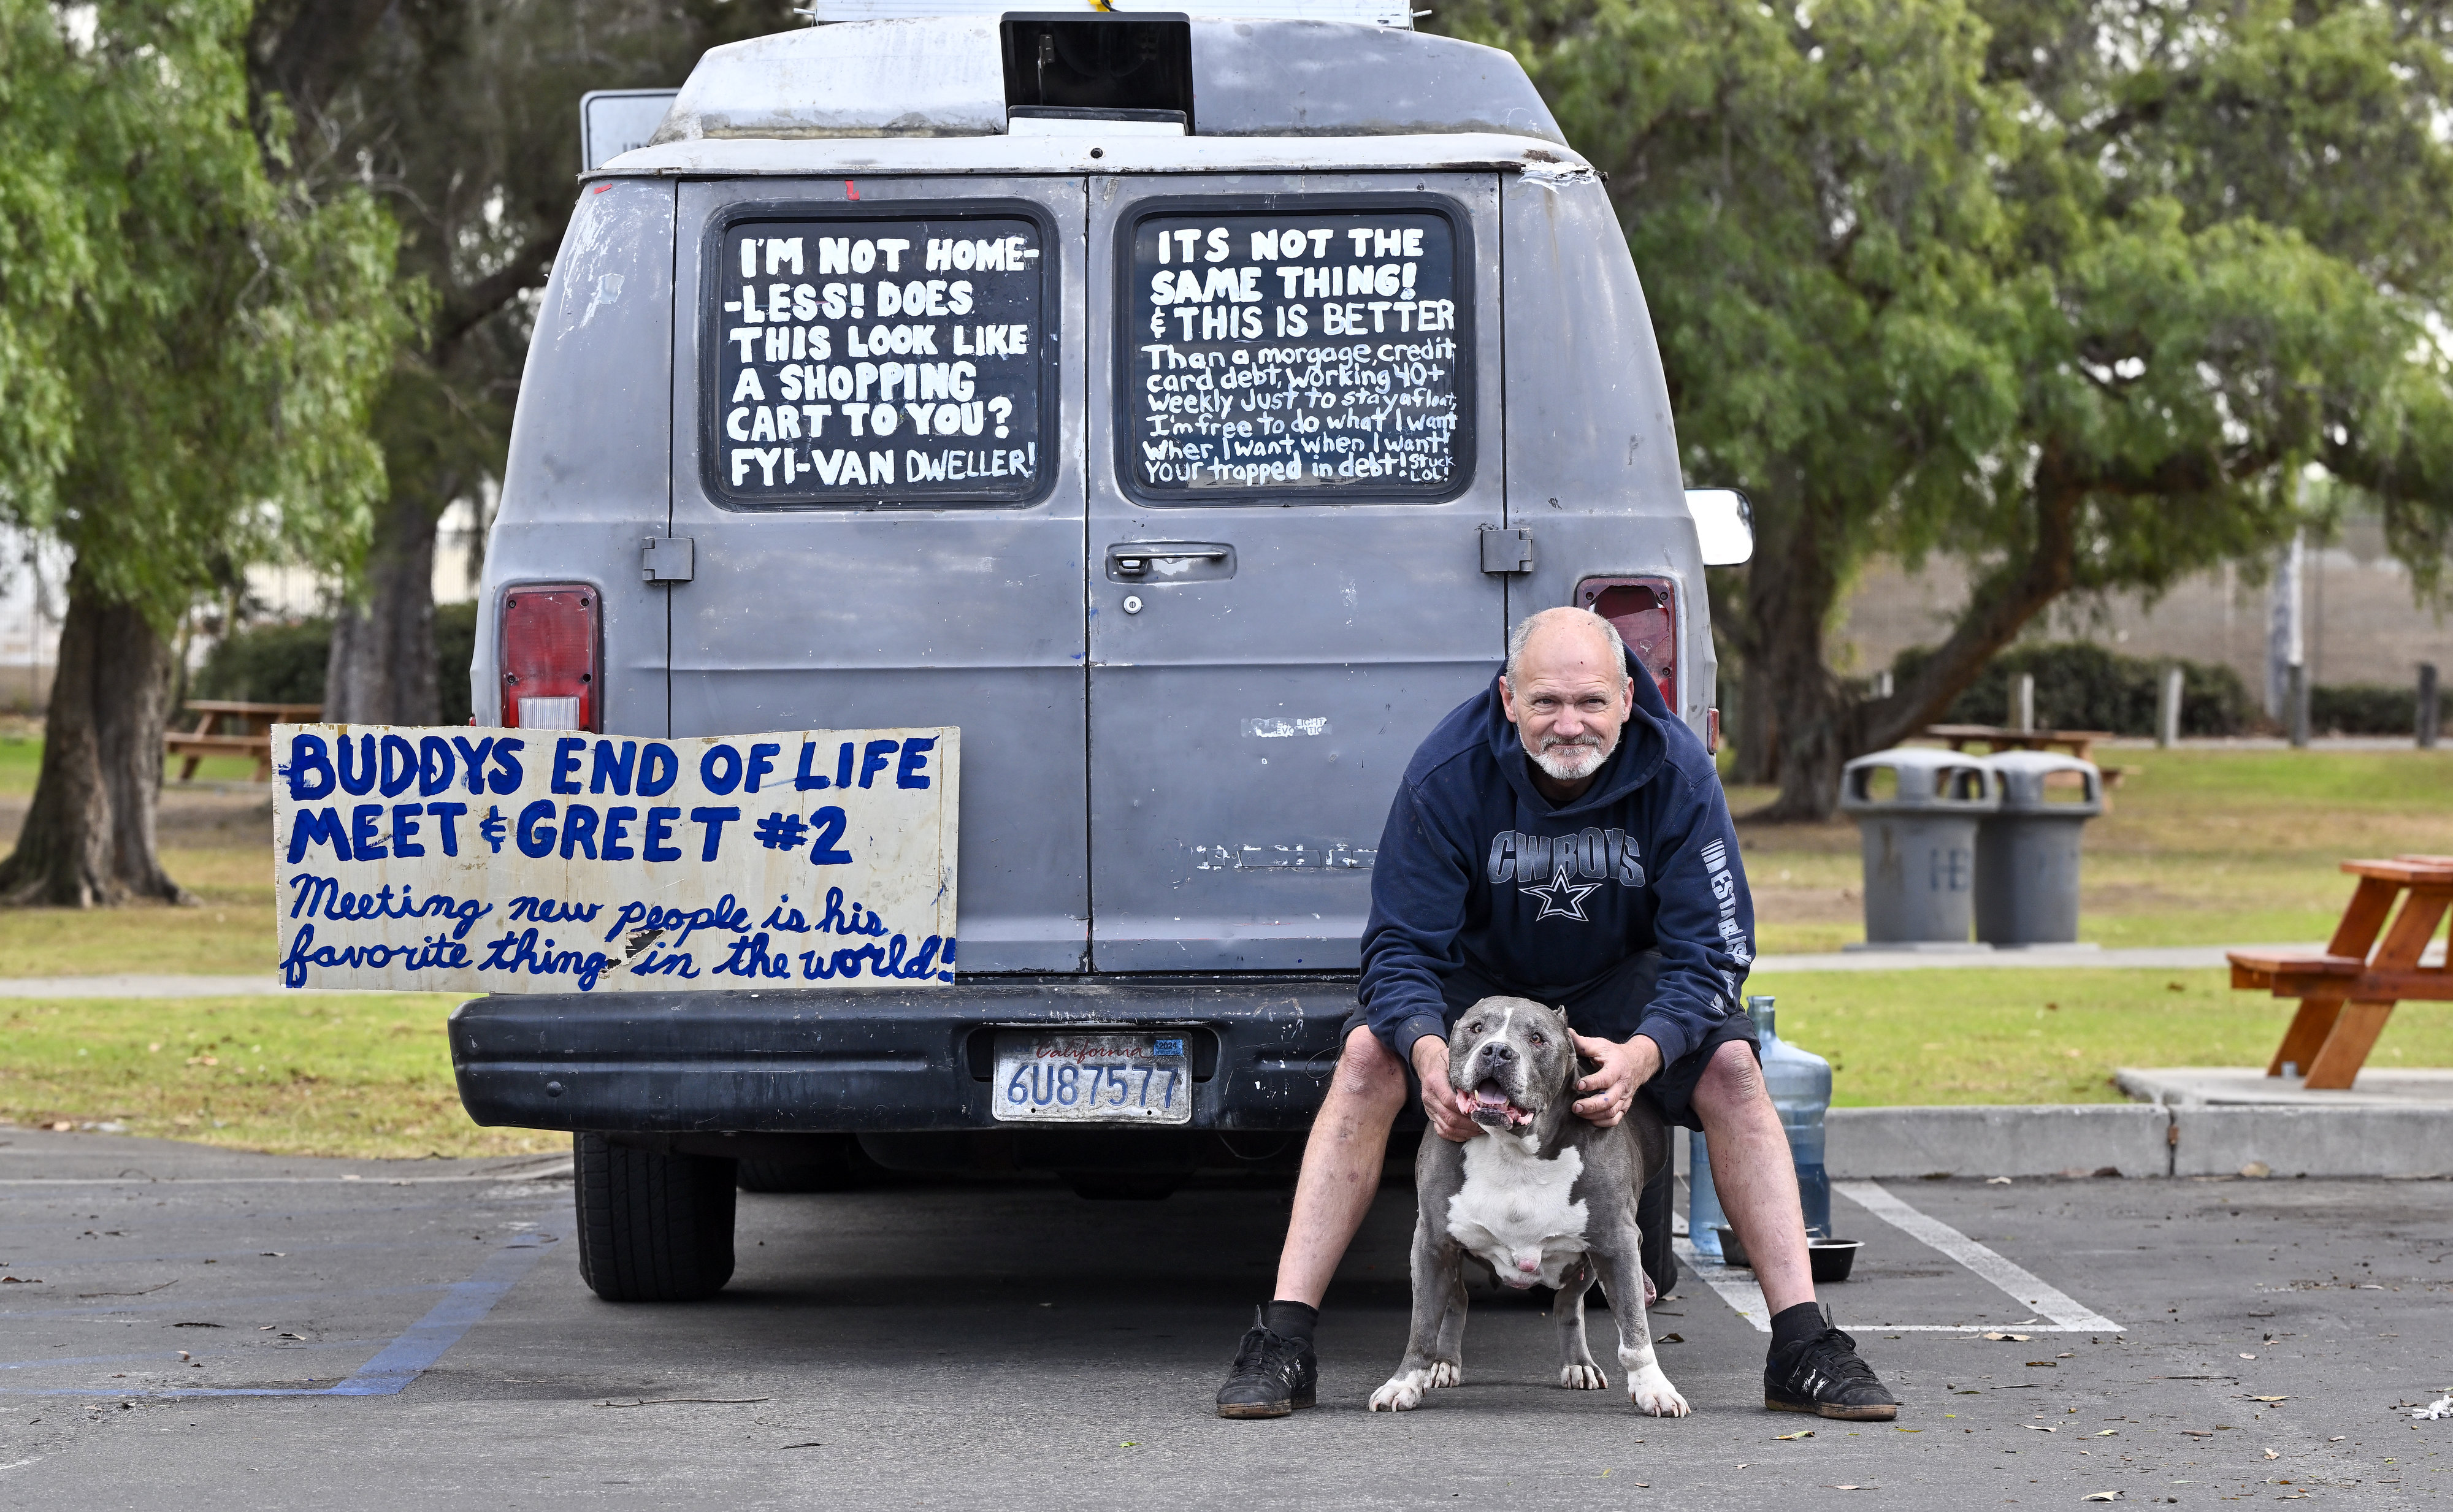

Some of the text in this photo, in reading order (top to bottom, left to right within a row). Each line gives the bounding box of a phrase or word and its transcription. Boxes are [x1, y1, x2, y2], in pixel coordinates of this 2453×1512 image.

[741, 237, 1039, 278] I'M NOT HOME-
[1158, 227, 1424, 264] ITS NOT THE
[724, 280, 974, 324] -LESS! DOES
[1150, 262, 1417, 305] SAME THING!
[1150, 299, 1455, 342] & THIS IS BETTER
[729, 324, 1028, 362] THIS LOOK LIKE
[1141, 337, 1456, 370] Than a morgage, credit
[732, 361, 977, 403] A SHOPPING
[1146, 366, 1215, 393] card
[1220, 362, 1282, 389] debt,
[1392, 362, 1445, 388] 40+
[727, 396, 1012, 441] CART TO YOU?
[1304, 386, 1336, 408] to
[1341, 387, 1399, 416] stay
[1146, 407, 1458, 438] I'm free to do what I want
[731, 441, 1036, 486] FYI-VAN DWELLER!
[1222, 437, 1230, 460] I
[1234, 433, 1295, 457] want
[1301, 431, 1365, 454] when
[1373, 431, 1379, 454] I
[1207, 456, 1302, 487] trapped
[1312, 454, 1333, 478] in
[1338, 451, 1407, 478] debt!
[289, 733, 939, 801] BUDDYS END OF LIFE
[287, 799, 854, 866] MEET & GREET #2
[1487, 827, 1646, 887] CWBOYS
[289, 872, 891, 948] Meeting new people is his
[280, 923, 955, 991] favorite thing in the world!
[1036, 1039, 1150, 1064] California
[1007, 1064, 1179, 1108] 6U87577
